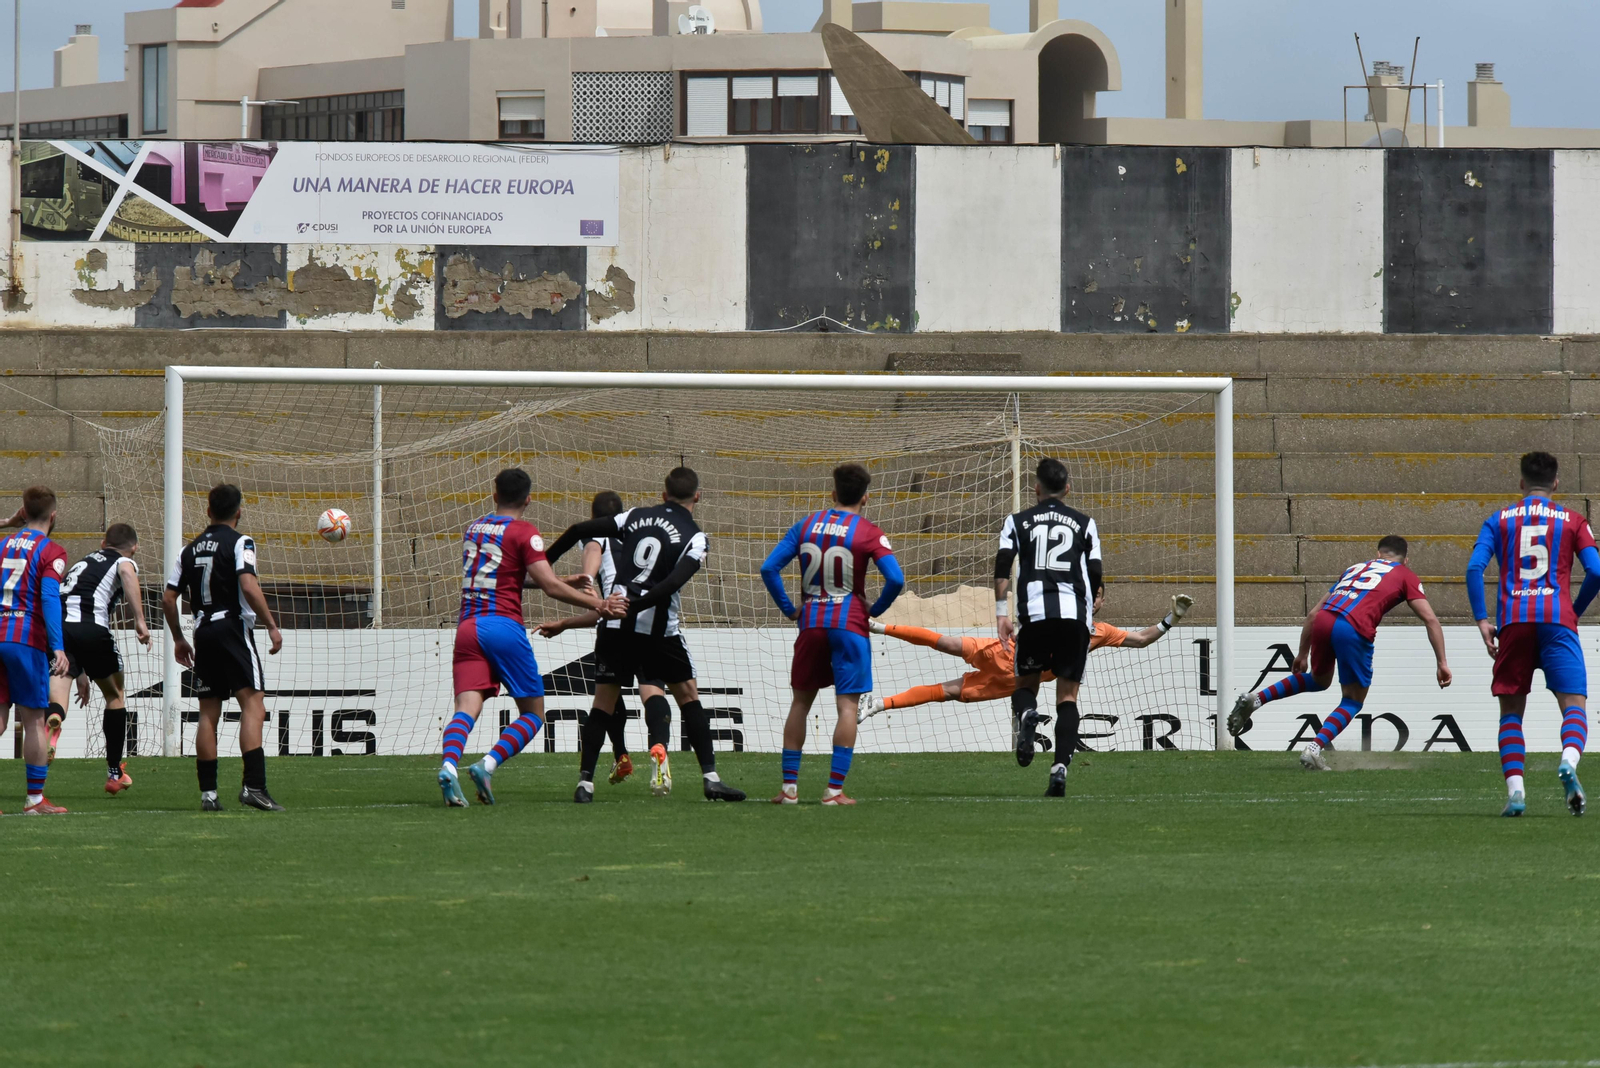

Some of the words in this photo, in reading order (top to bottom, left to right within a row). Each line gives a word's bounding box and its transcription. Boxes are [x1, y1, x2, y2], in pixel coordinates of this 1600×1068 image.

[205, 149, 227, 160] MERCADO
[228, 153, 234, 161] DE
[315, 153, 353, 162] FONDOS
[356, 153, 400, 162] EUROPEOS
[403, 154, 414, 162] DE
[416, 154, 470, 163] DESARROLLO
[473, 154, 516, 163] REGIONAL
[518, 155, 549, 165] (FEDER)
[293, 177, 331, 192] UNA
[337, 177, 412, 193] MANERA
[418, 178, 440, 193] DE
[445, 178, 502, 194] HACER
[507, 179, 575, 195] EUROPA
[362, 210, 418, 220] PROYECTOS
[421, 211, 503, 221] COFINANCIADOS
[373, 224, 393, 233] POR
[396, 224, 408, 233] LA
[410, 222, 445, 234] UNIÓN
[447, 225, 492, 234] EUROPEA
[1033, 511, 1081, 533] MONTEVERDE
[1501, 506, 1526, 519] MIKA
[1529, 503, 1570, 522] MÁRMOL
[472, 523, 506, 536] ESCOBAR
[628, 517, 653, 533] IVÁN
[654, 517, 681, 544] MARTÍN
[6, 537, 36, 551] PEQUE
[1030, 524, 1073, 571] 12
[1519, 525, 1549, 580] 5
[462, 540, 503, 589] 22
[632, 536, 662, 584] 9
[800, 542, 854, 597] 20
[1, 557, 28, 606] 7
[59, 561, 88, 595] 3
[194, 556, 213, 606] 7
[1333, 562, 1395, 591] 23
[1511, 587, 1543, 597] unicef
